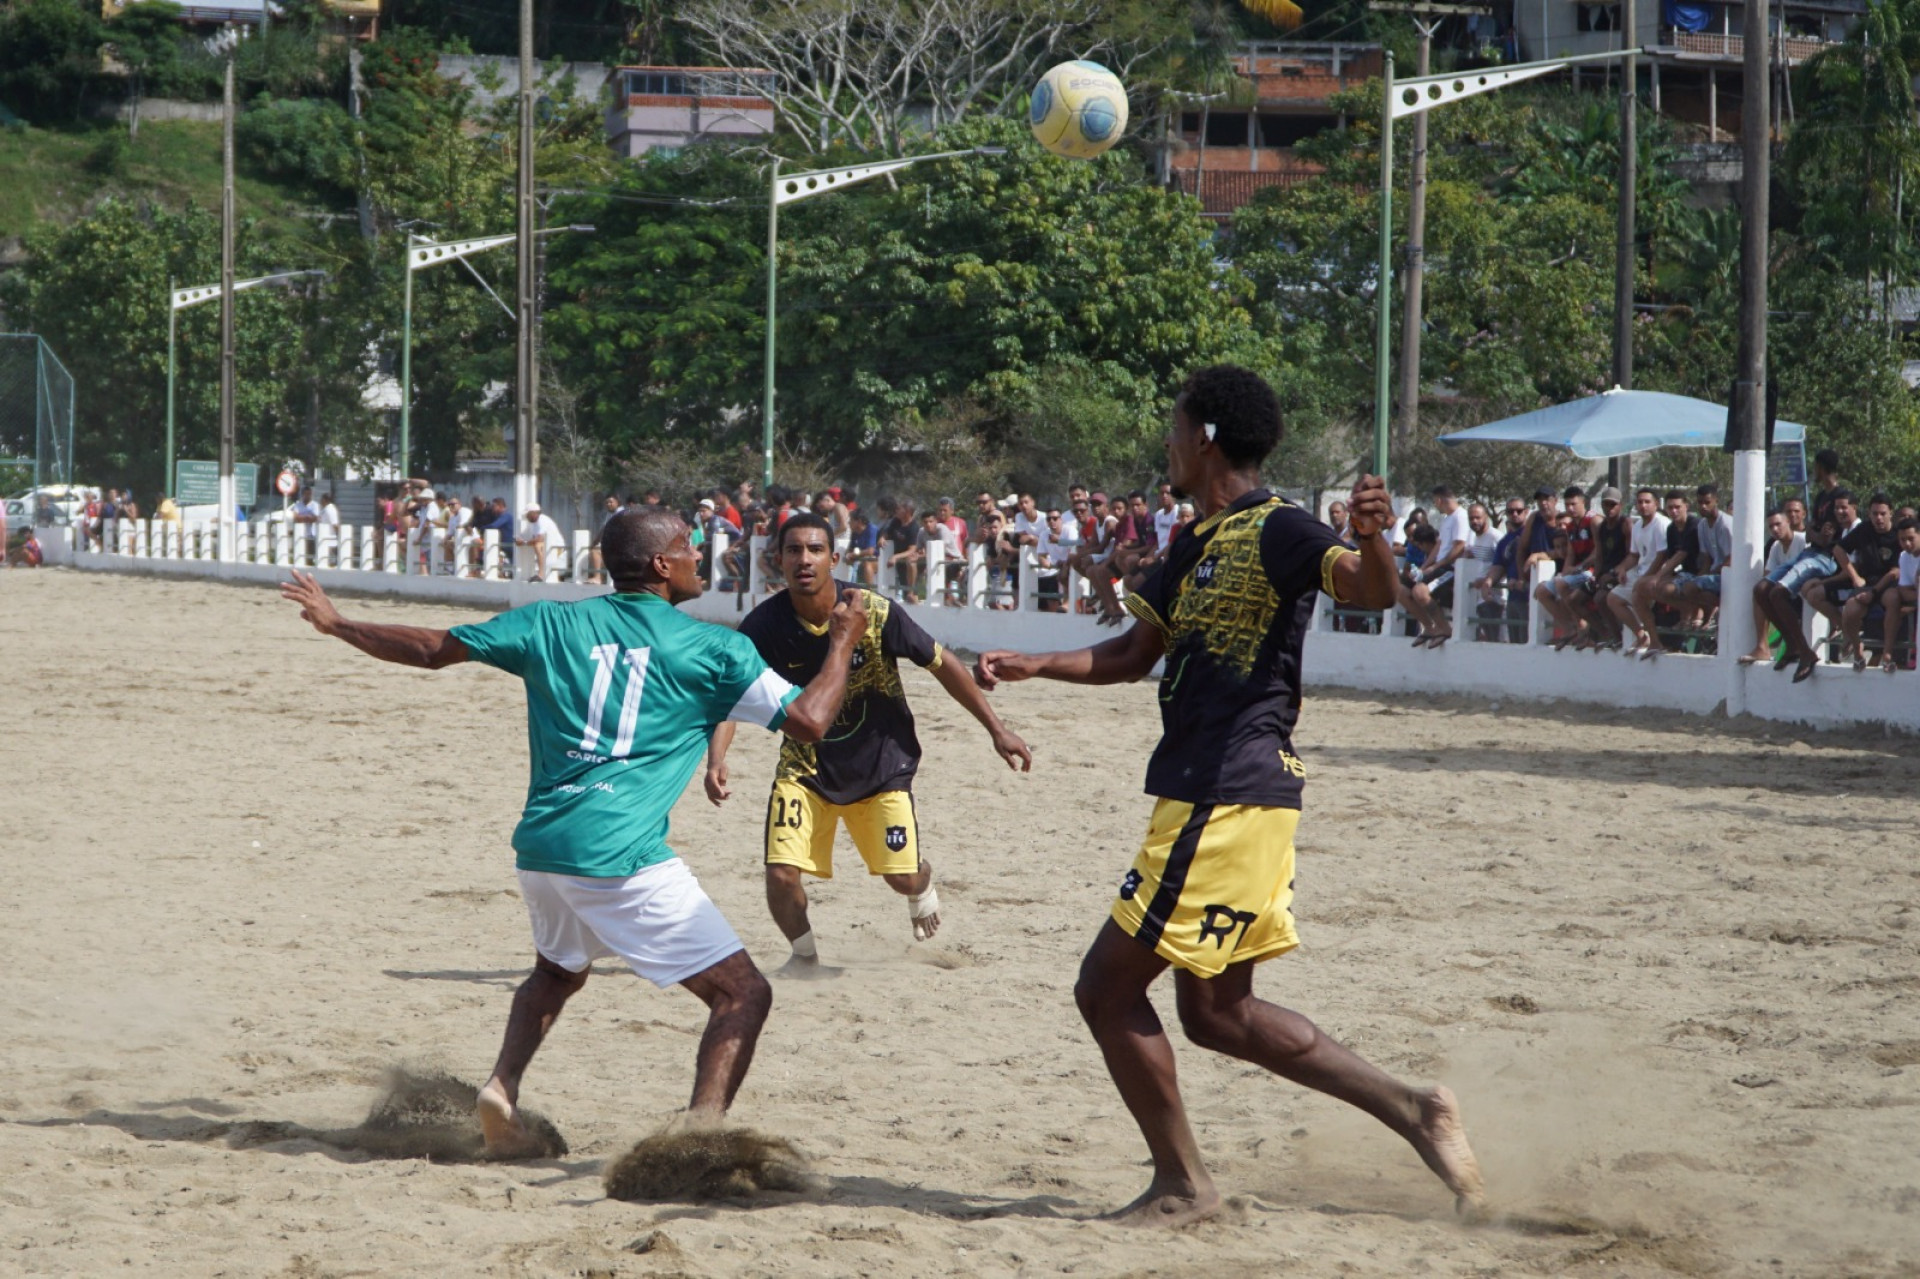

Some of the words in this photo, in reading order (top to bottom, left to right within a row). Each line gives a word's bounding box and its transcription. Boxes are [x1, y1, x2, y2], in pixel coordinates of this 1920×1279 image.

[580, 643, 651, 757] 11
[774, 797, 803, 829] 13
[1198, 904, 1258, 953] RT
